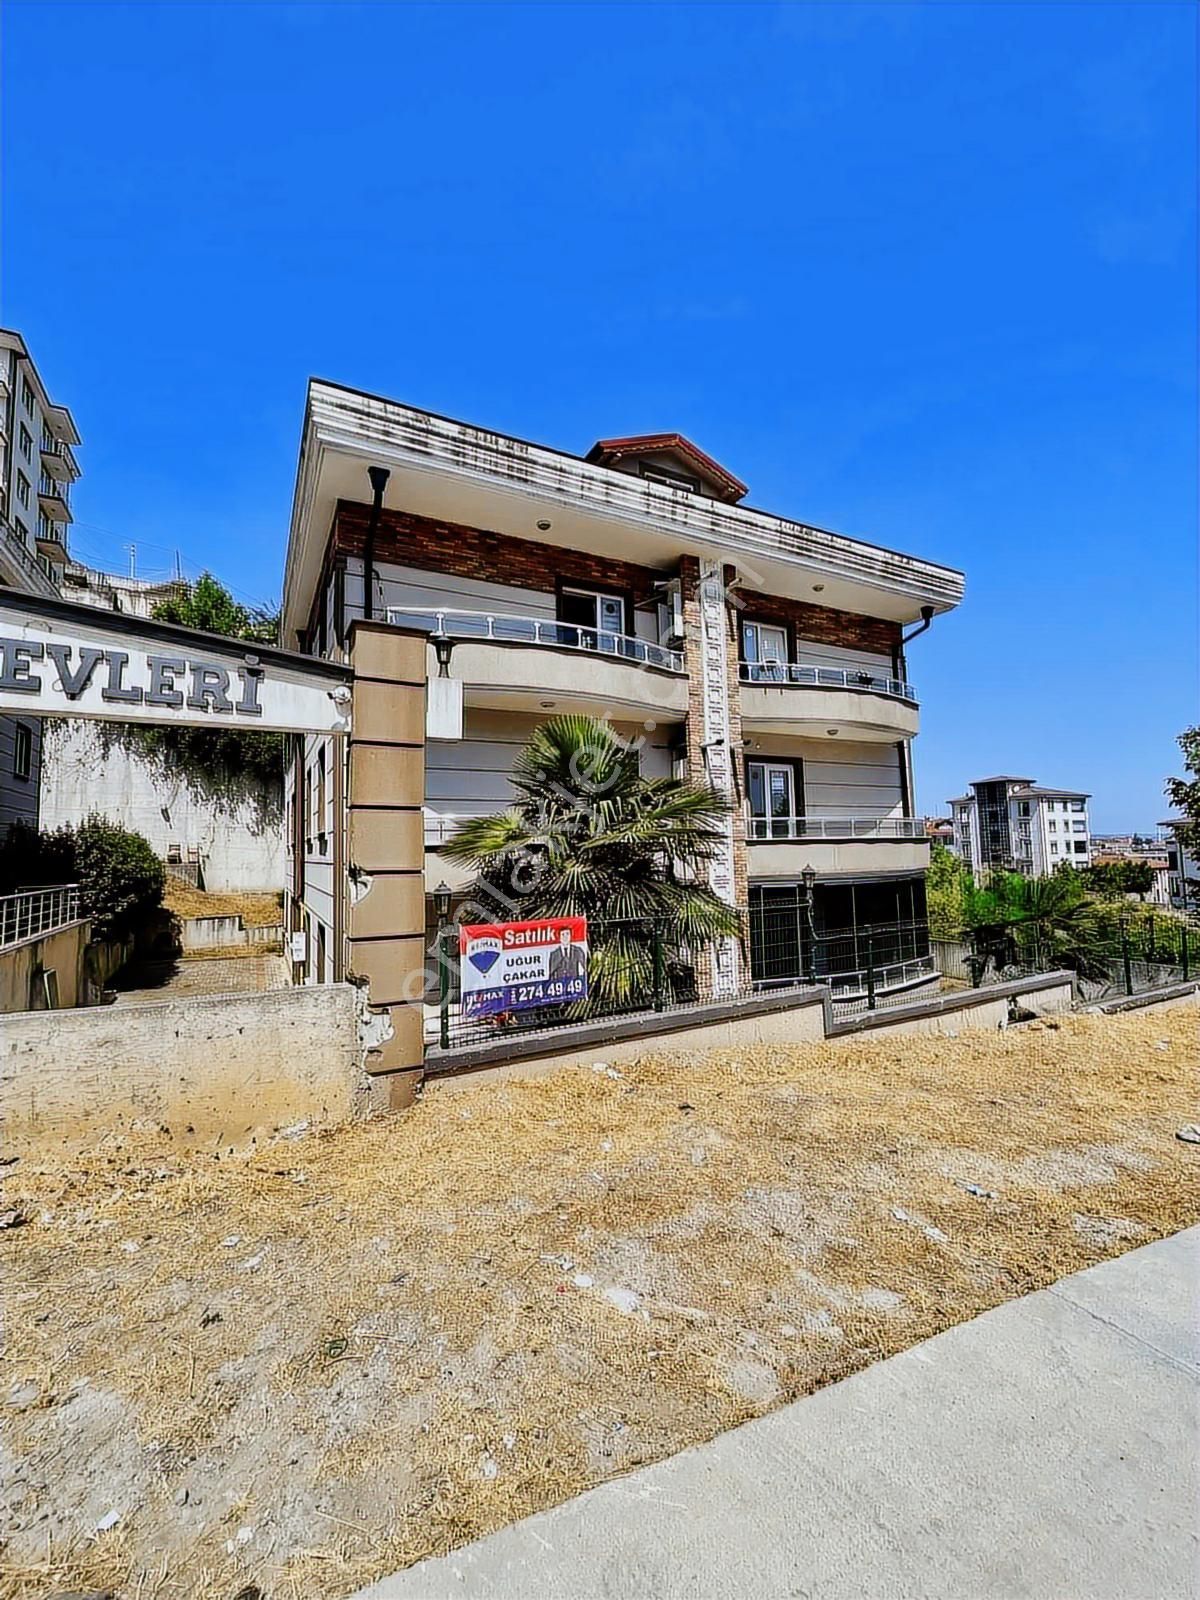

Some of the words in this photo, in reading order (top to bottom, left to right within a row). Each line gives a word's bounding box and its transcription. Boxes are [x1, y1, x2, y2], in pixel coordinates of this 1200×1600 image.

[0, 638, 264, 716] EVLERİ
[504, 926, 556, 945] Satılık
[506, 954, 541, 967] UĞUR
[503, 968, 545, 983] ÇAKAR
[519, 985, 544, 1001] 274
[547, 982, 563, 996] 49
[567, 979, 582, 994] 49
